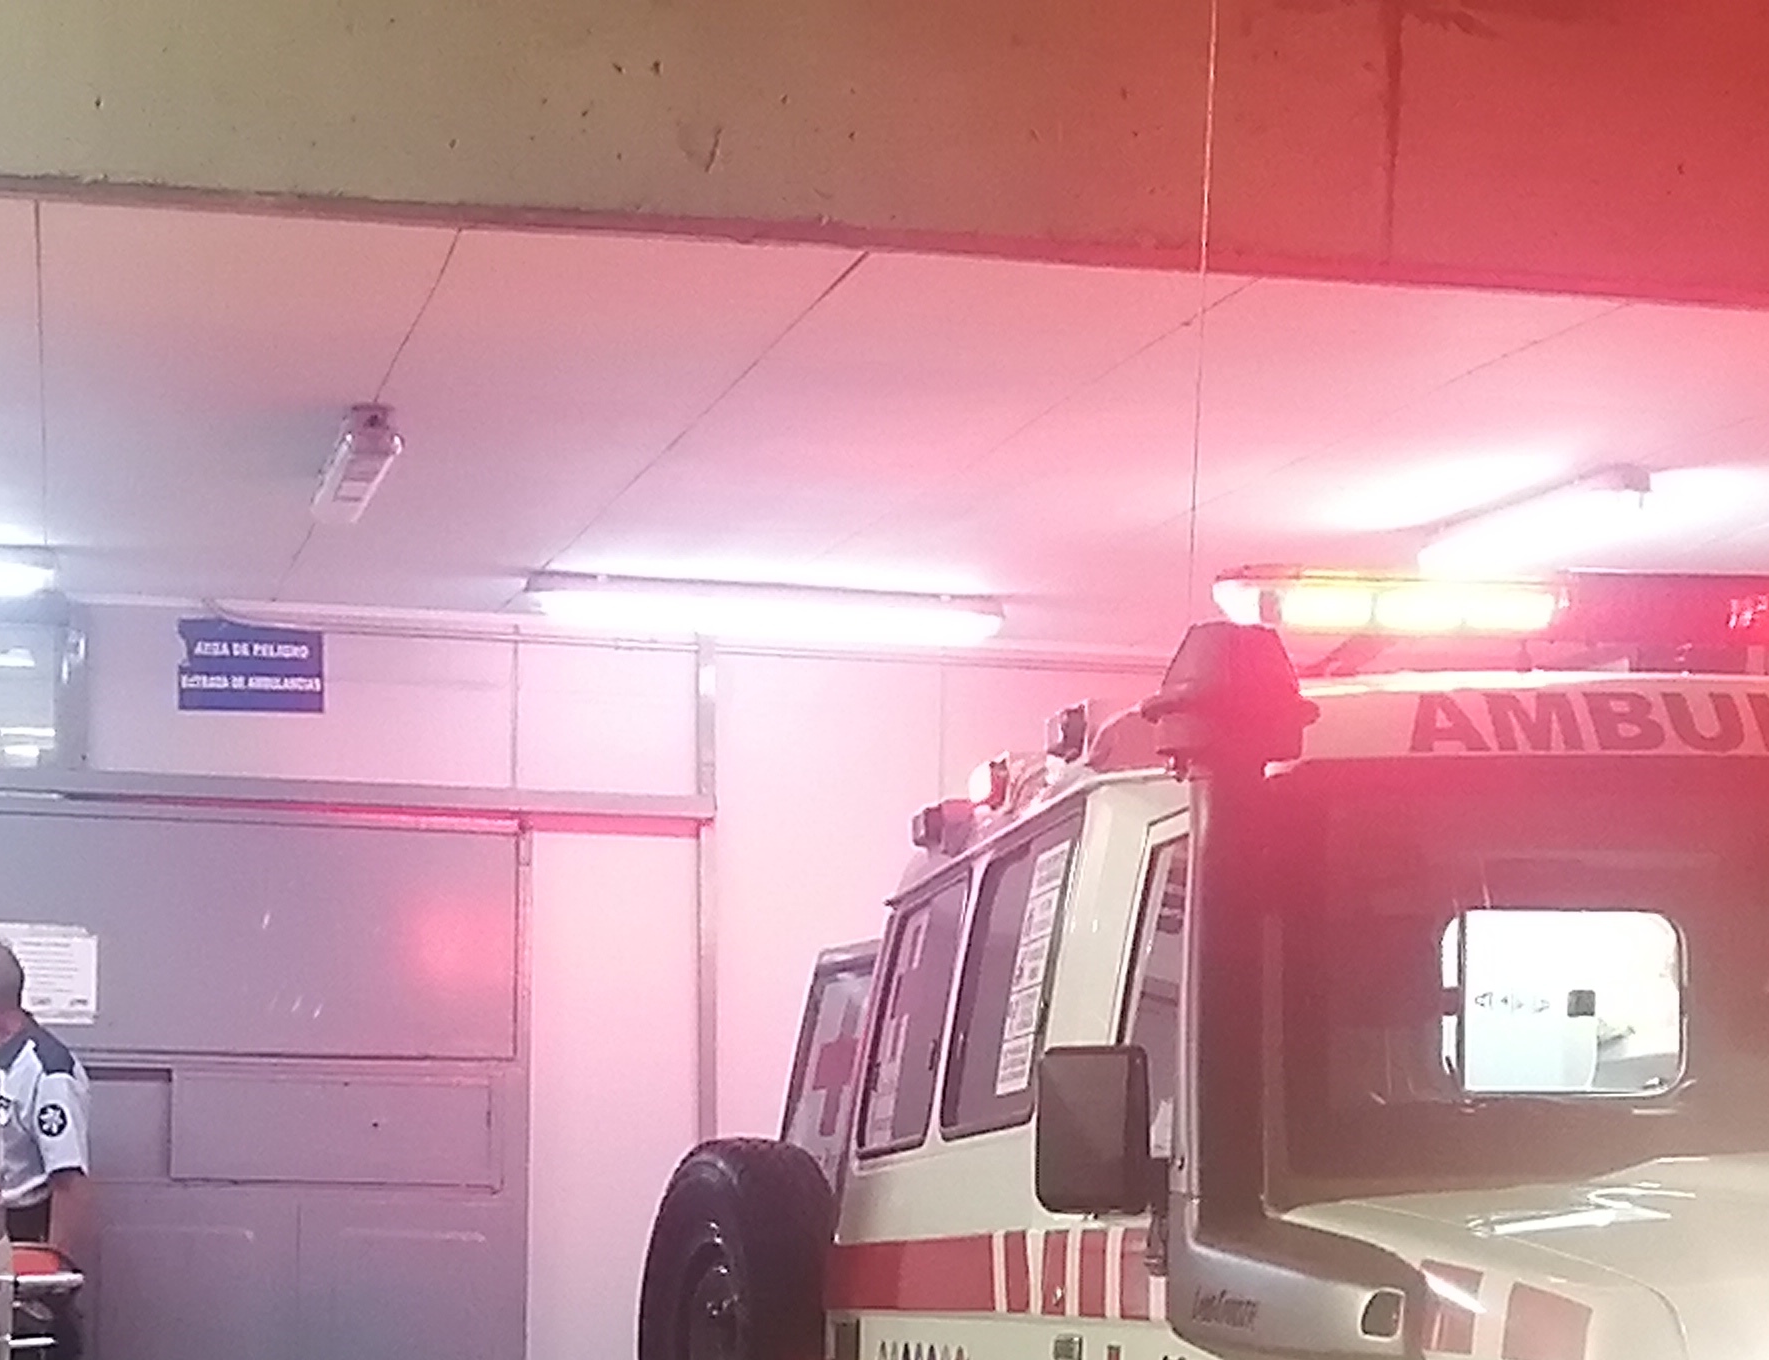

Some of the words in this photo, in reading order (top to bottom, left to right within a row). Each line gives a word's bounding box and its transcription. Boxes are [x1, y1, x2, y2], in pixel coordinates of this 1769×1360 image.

[232, 642, 250, 657] DE
[252, 643, 310, 660] PELIGRO
[247, 676, 322, 692] AMBULANCIAS
